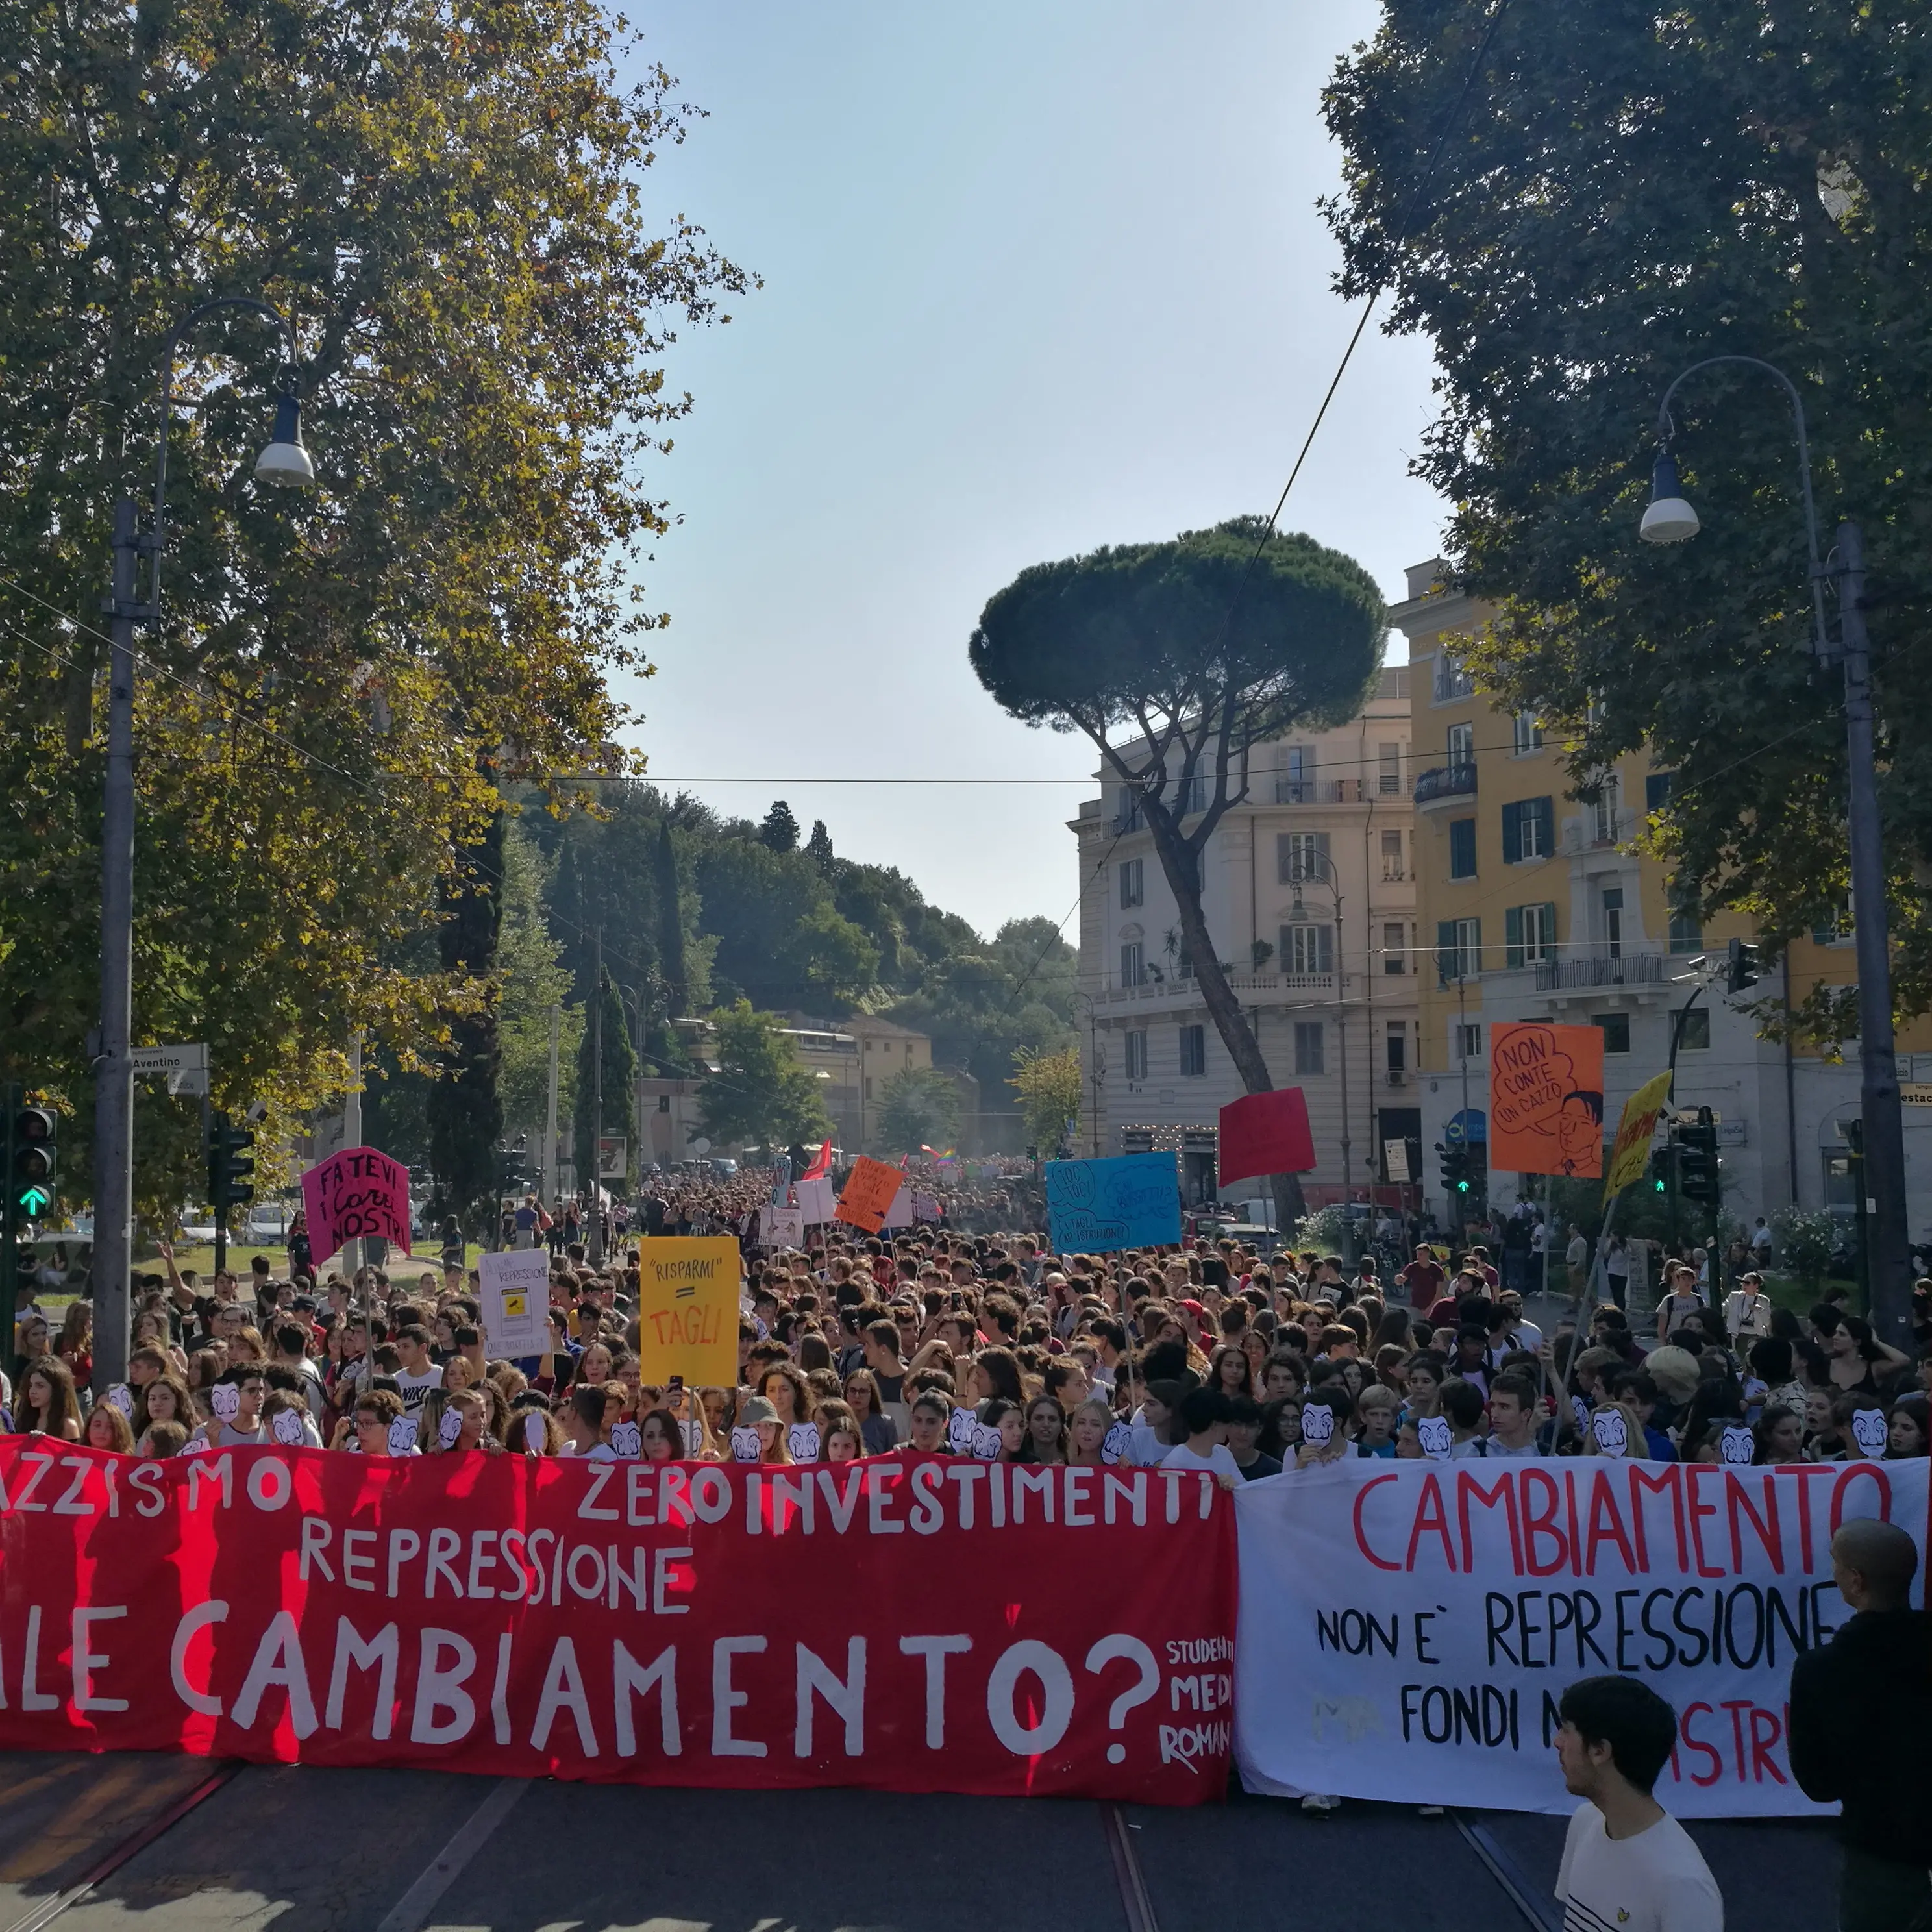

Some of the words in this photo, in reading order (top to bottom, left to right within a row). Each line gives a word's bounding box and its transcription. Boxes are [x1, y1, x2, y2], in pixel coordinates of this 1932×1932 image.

[132, 1057, 180, 1068] Aventino
[1502, 1034, 1546, 1072] NON
[1504, 1062, 1557, 1095] CONTE
[1901, 1093, 1932, 1102] estac
[1498, 1104, 1519, 1123] UN
[1519, 1082, 1562, 1113] CAZZO
[320, 1154, 397, 1196] FATEVI
[1058, 1165, 1080, 1185] TOC
[332, 1208, 406, 1253] NOSTRI
[1072, 1215, 1094, 1230] TAGLI
[499, 1265, 549, 1282] REPRESSIONE
[649, 1257, 723, 1283] "RISPARMI"
[649, 1303, 723, 1346] TAGLI
[577, 1463, 733, 1527] ZERO
[745, 1463, 1215, 1535] INVESTIMENTI
[1353, 1463, 1892, 1578] CAMBIAMENTO
[299, 1516, 695, 1615] REPRESSIONE
[1317, 1608, 1399, 1658] NON
[1485, 1581, 1838, 1672] REPRESSIONE
[0, 1604, 130, 1713] LE
[169, 1598, 1161, 1765] CAMBIAMENTO?
[1400, 1683, 1520, 1752] FONDI
